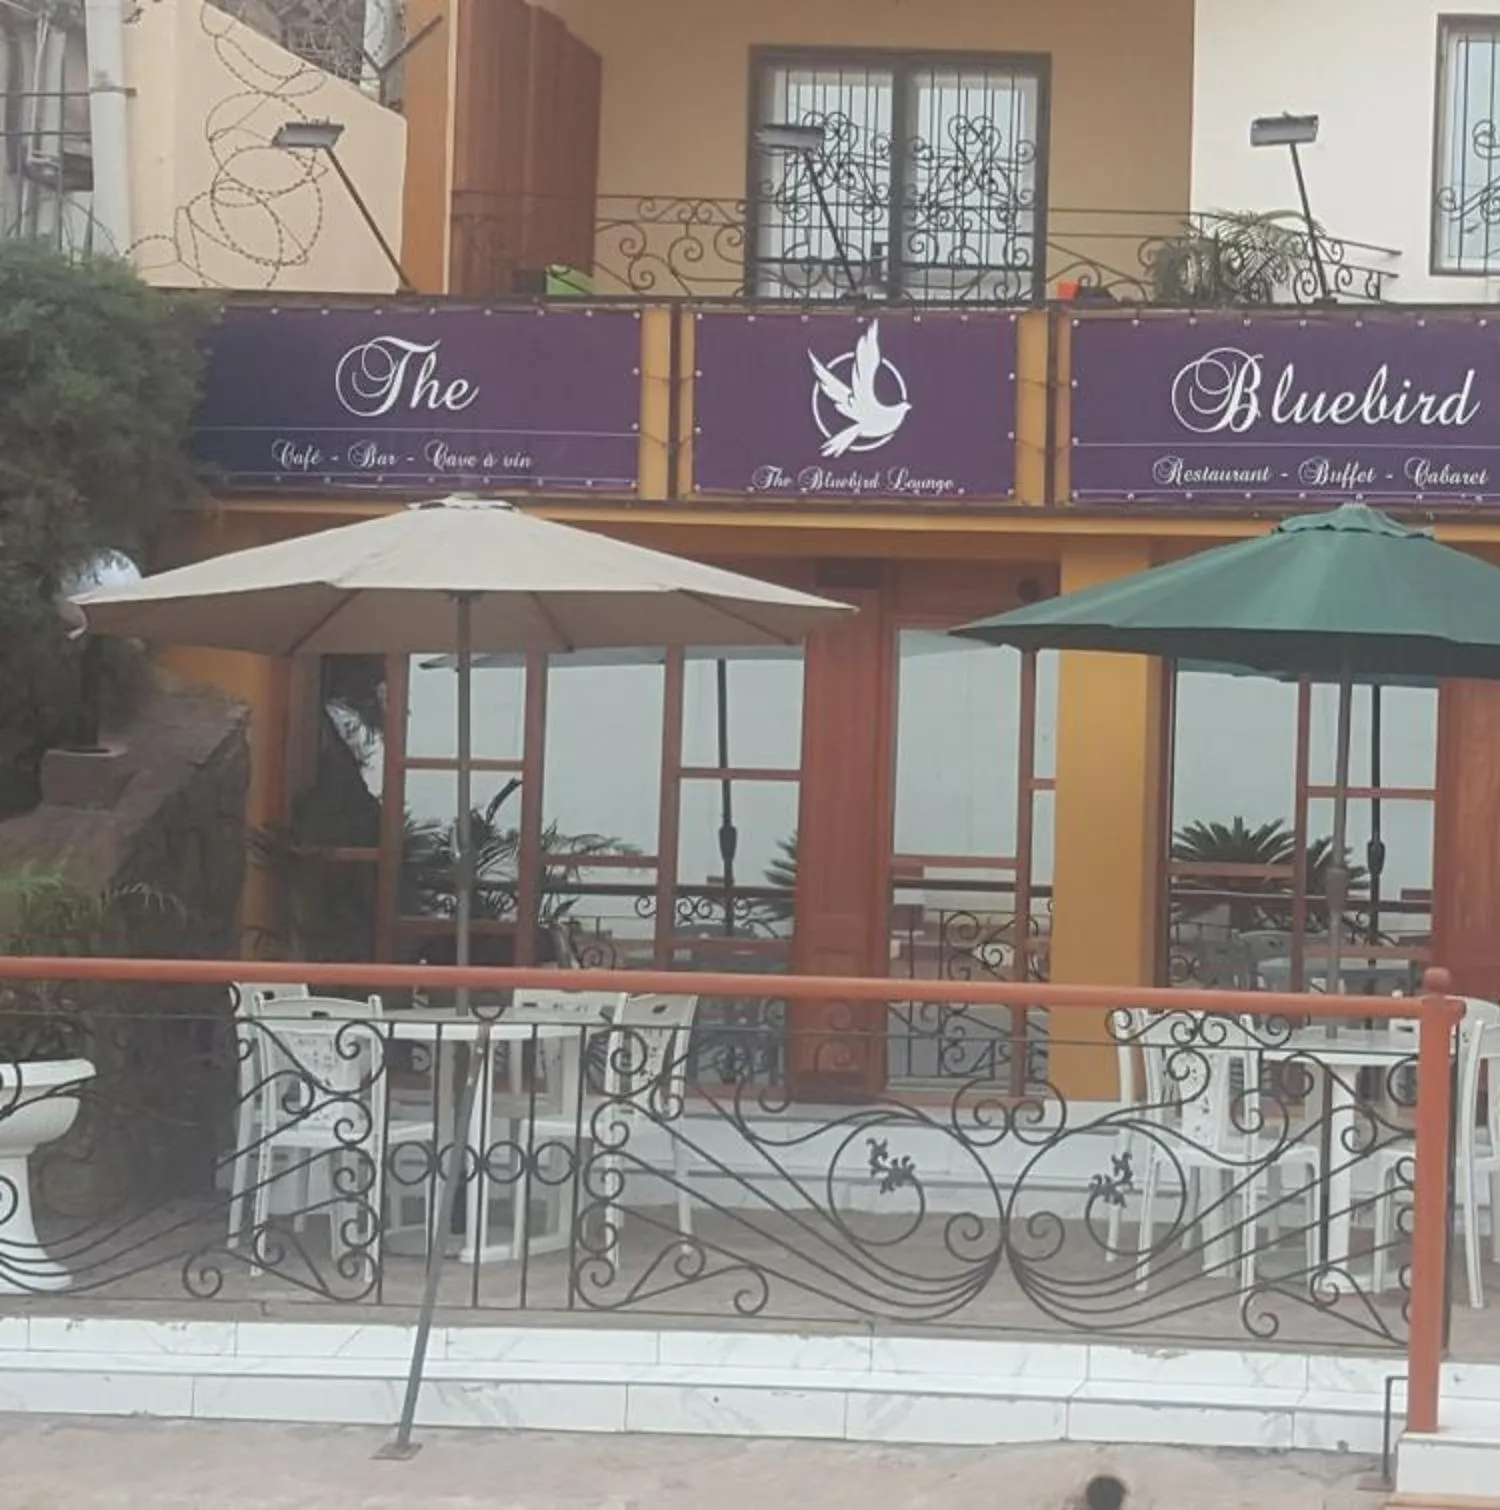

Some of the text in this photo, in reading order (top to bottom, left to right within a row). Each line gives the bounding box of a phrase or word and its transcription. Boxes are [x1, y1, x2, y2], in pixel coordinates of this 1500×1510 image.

[335, 335, 480, 417] The
[1171, 347, 1481, 433] Bluebird
[347, 439, 398, 469] Bar
[425, 439, 478, 472] Cave
[502, 450, 532, 470] vin
[752, 465, 954, 496] The Bluebird Lounge
[1153, 456, 1271, 485] Restaurant
[1300, 456, 1377, 489] Buffet
[1404, 457, 1489, 488] Cabaret
